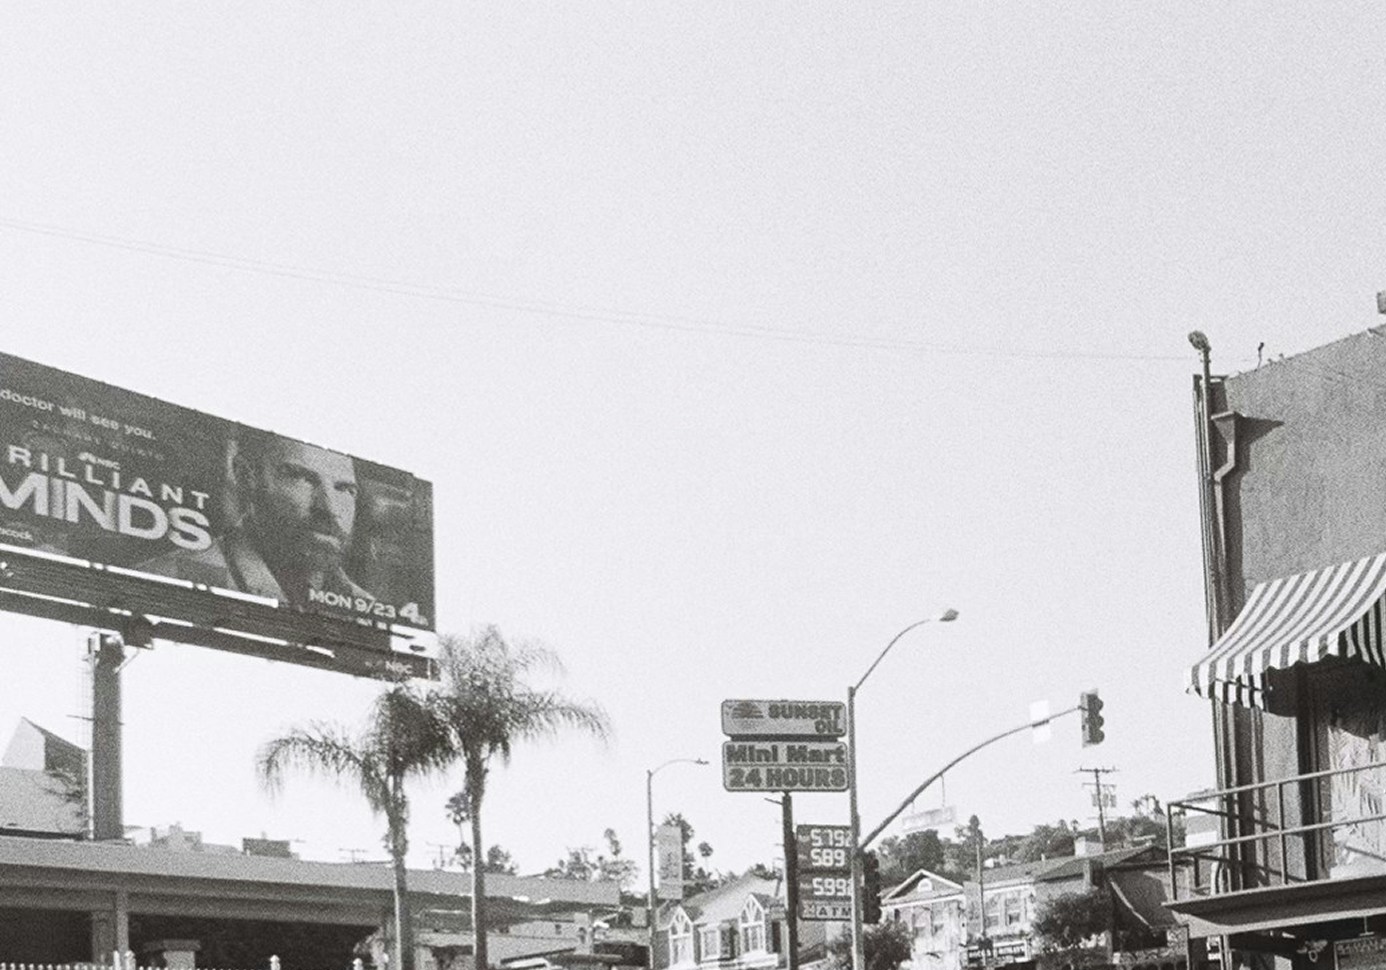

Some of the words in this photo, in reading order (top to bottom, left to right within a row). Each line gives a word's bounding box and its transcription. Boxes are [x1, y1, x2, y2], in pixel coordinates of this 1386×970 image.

[0, 388, 54, 412] doctor
[59, 405, 86, 421] will
[90, 414, 119, 430] see
[123, 424, 157, 440] you.
[8, 445, 210, 509] RILLIANT
[0, 472, 212, 550] MINDS
[309, 588, 352, 610] MON
[354, 598, 396, 619] 9/23
[399, 602, 419, 622] 4
[768, 704, 842, 720] SUNSET
[814, 720, 843, 734] OIL
[726, 744, 778, 763] Mini
[786, 743, 845, 763] Mart
[729, 768, 762, 788] 24
[766, 768, 845, 788] HOURS
[819, 907, 852, 917] ATM
